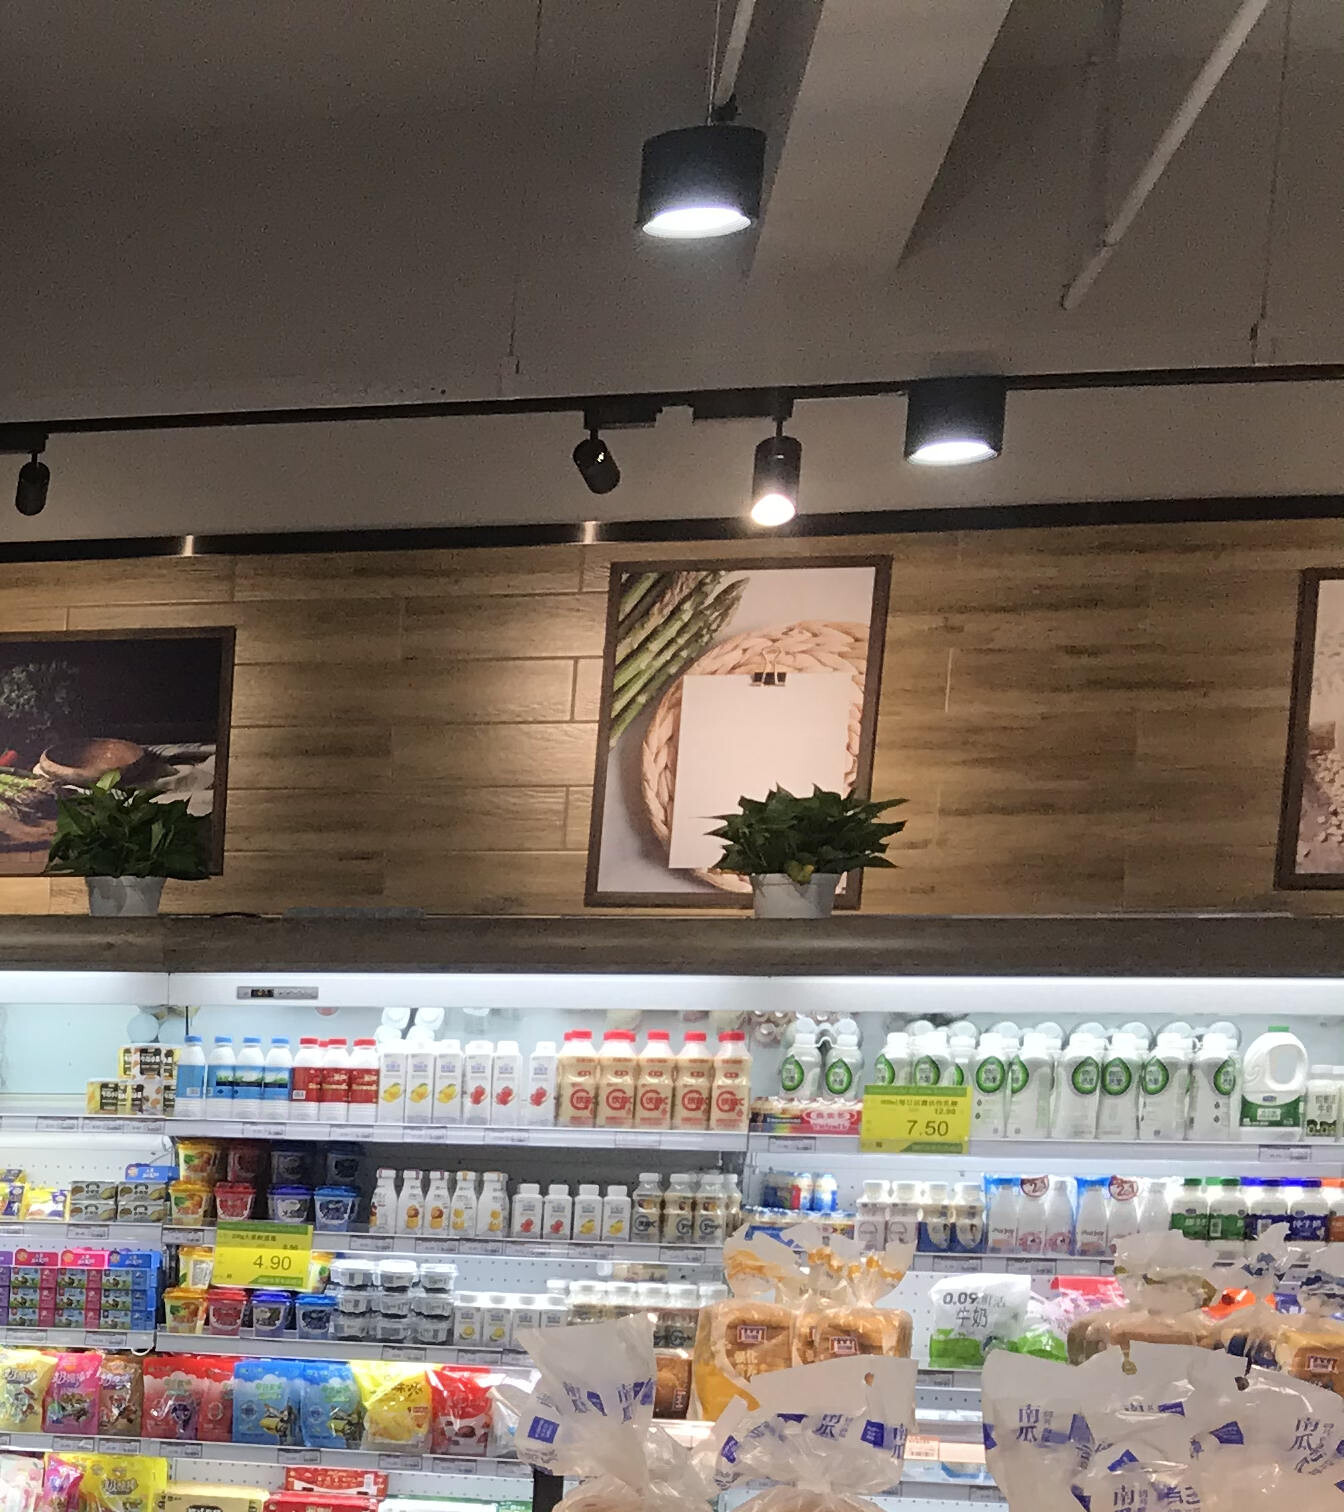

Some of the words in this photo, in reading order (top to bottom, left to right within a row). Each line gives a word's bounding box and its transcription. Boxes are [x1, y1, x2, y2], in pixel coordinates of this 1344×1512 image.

[907, 1119, 949, 1137] 7.50
[253, 1255, 292, 1270] 4.90
[943, 1291, 978, 1305] 0.09
[955, 1306, 988, 1329] 牛奶
